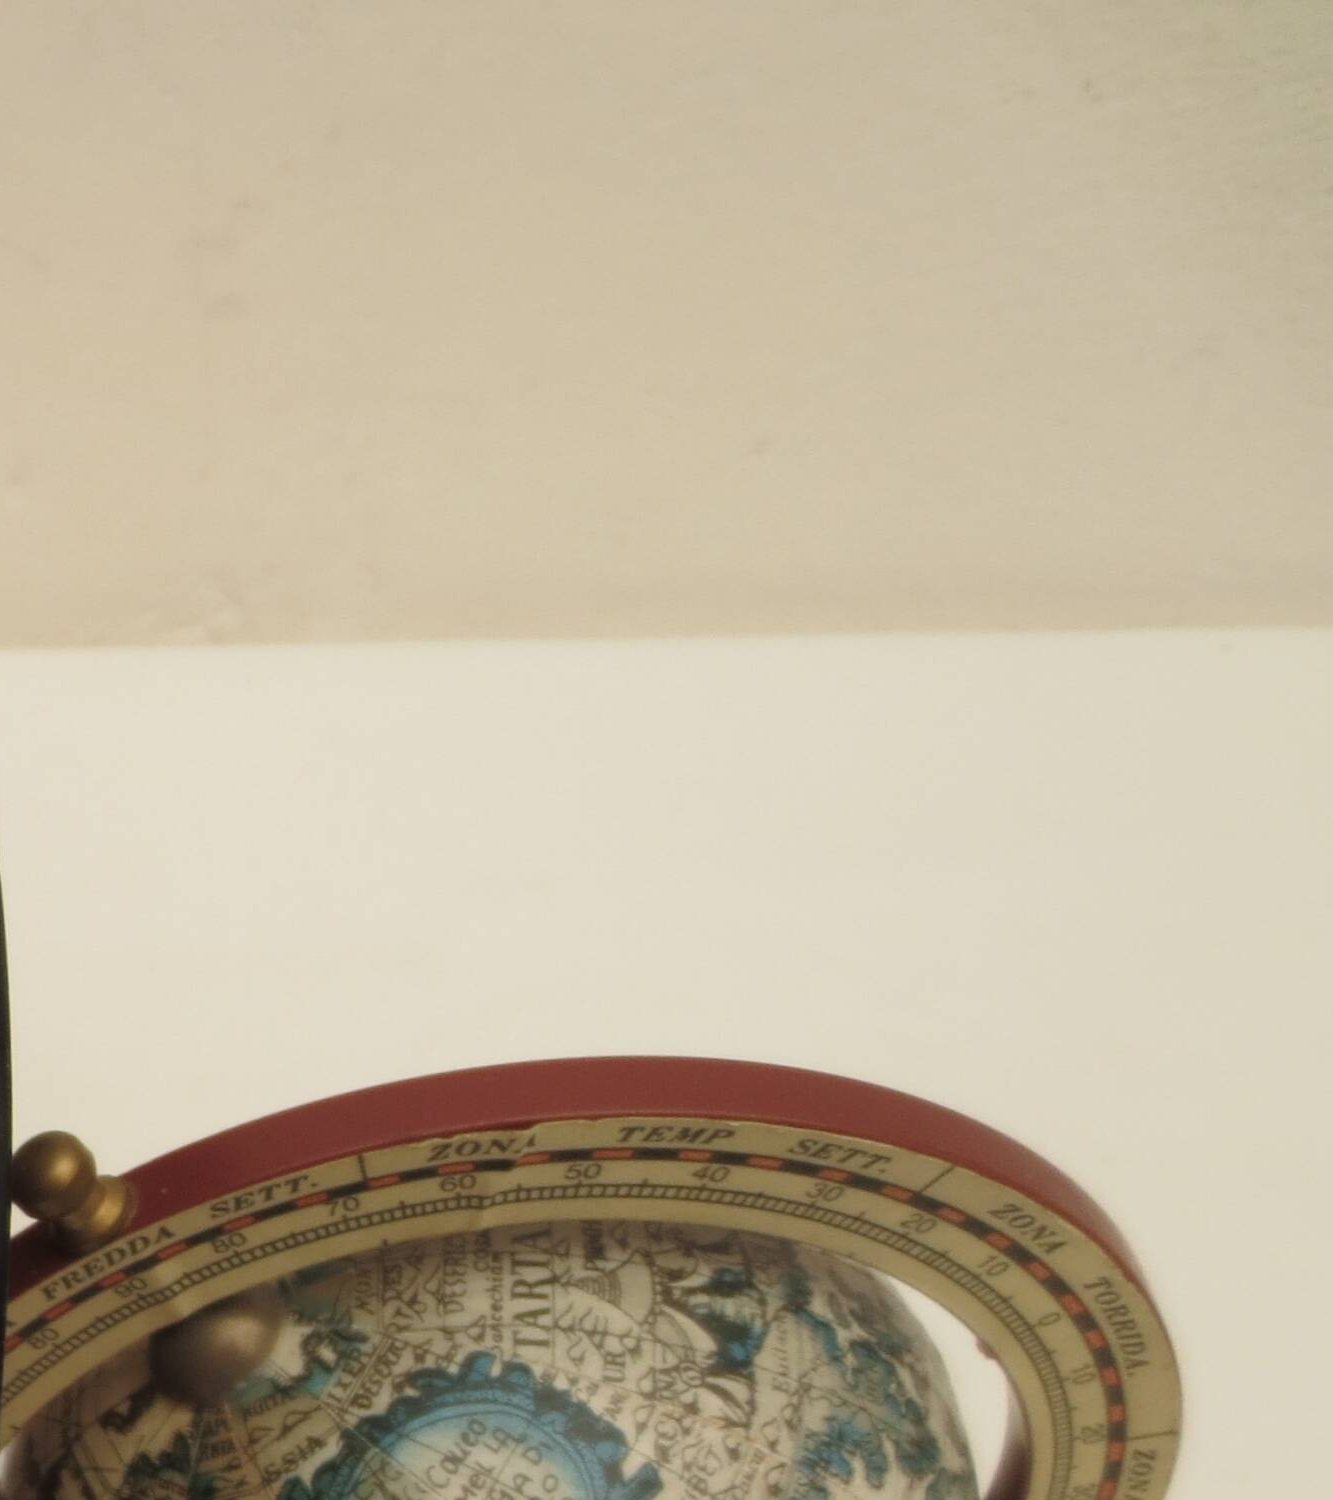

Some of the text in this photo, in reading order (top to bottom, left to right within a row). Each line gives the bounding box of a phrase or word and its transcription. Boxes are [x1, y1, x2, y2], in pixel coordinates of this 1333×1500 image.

[788, 1137, 893, 1175] SETT.
[438, 1173, 479, 1193] 60
[564, 1161, 604, 1182] 50
[691, 1165, 731, 1184] 40
[805, 1180, 845, 1201] 30
[901, 1211, 936, 1237] 20
[986, 1202, 1069, 1256] ZONA
[40, 1173, 320, 1303] FREDDA SETT.
[210, 1231, 249, 1256] 80
[979, 1253, 1010, 1279] 10
